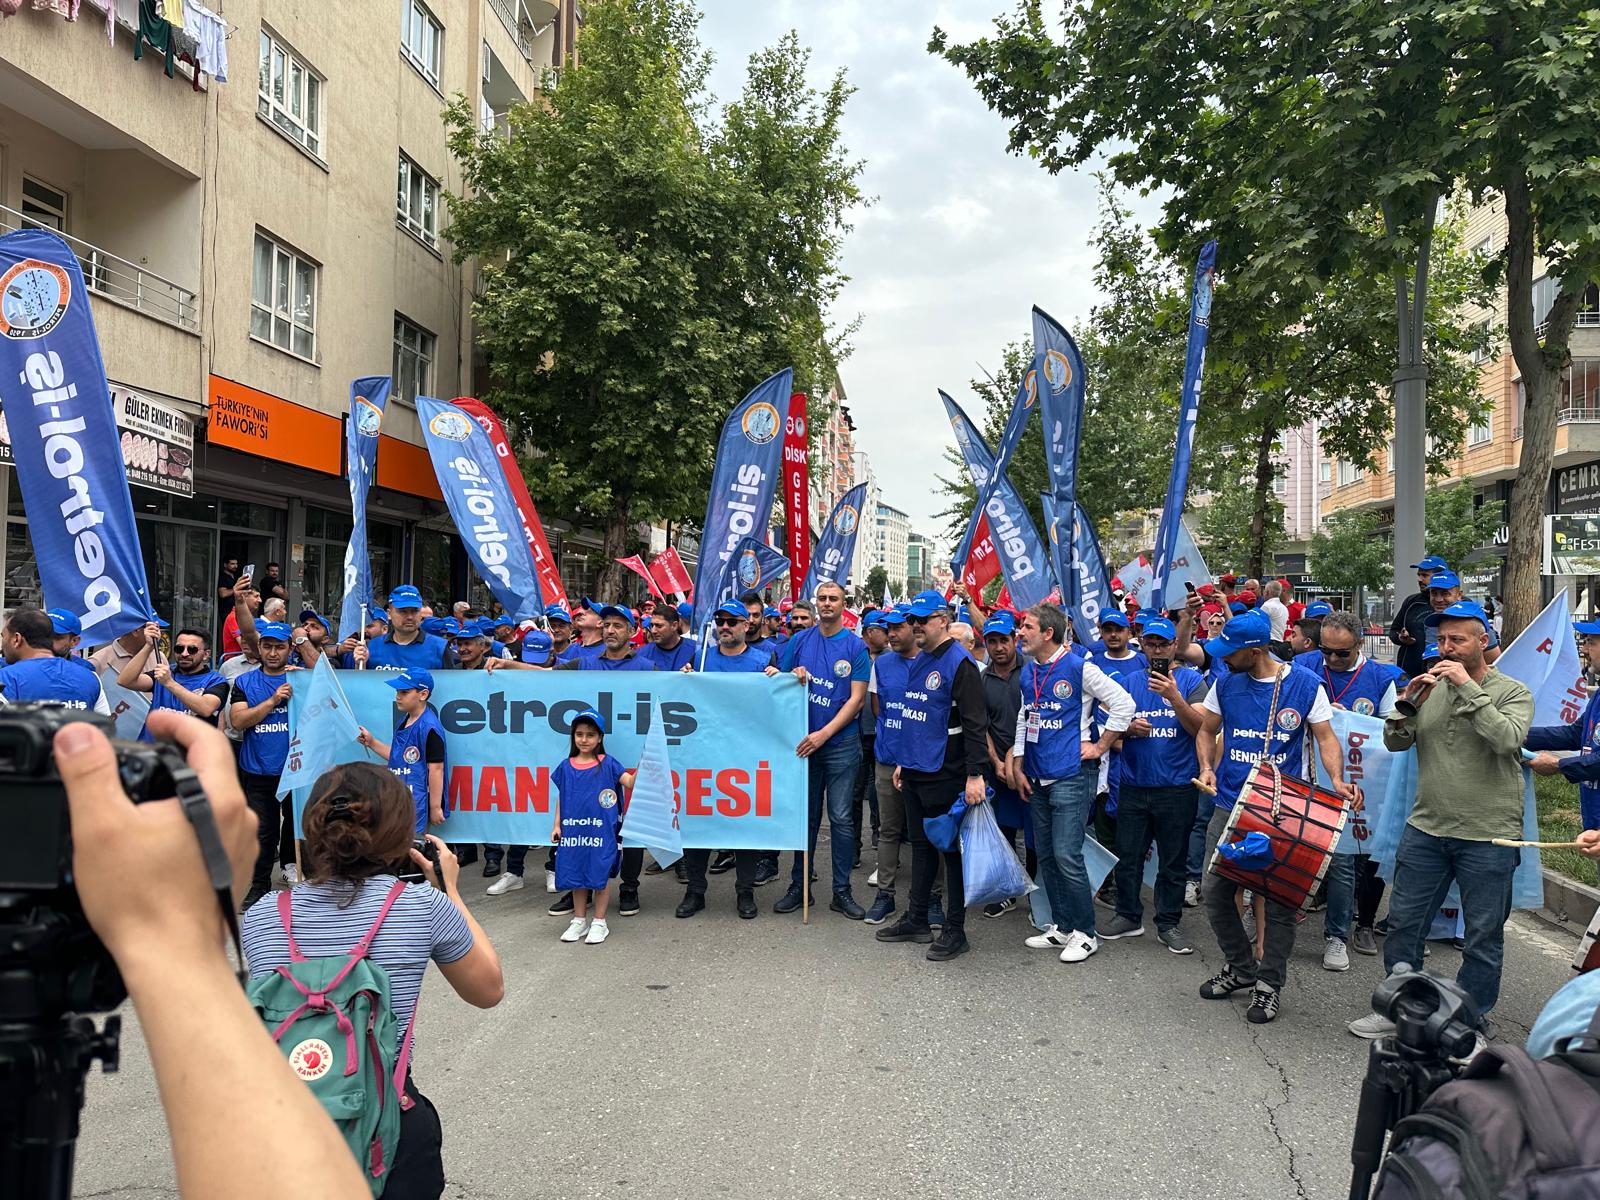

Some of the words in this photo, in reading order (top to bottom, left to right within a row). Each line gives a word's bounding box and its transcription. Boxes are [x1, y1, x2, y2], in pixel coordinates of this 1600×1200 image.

[124, 396, 150, 422] GÜLER
[216, 395, 269, 423] TÜRKİYE'NİN
[785, 444, 807, 464] DİSK
[1133, 709, 1176, 719] etrol-iş
[447, 766, 549, 813] MAN
[562, 817, 603, 828] etrol-iş
[560, 834, 603, 848] ENDİKASI
